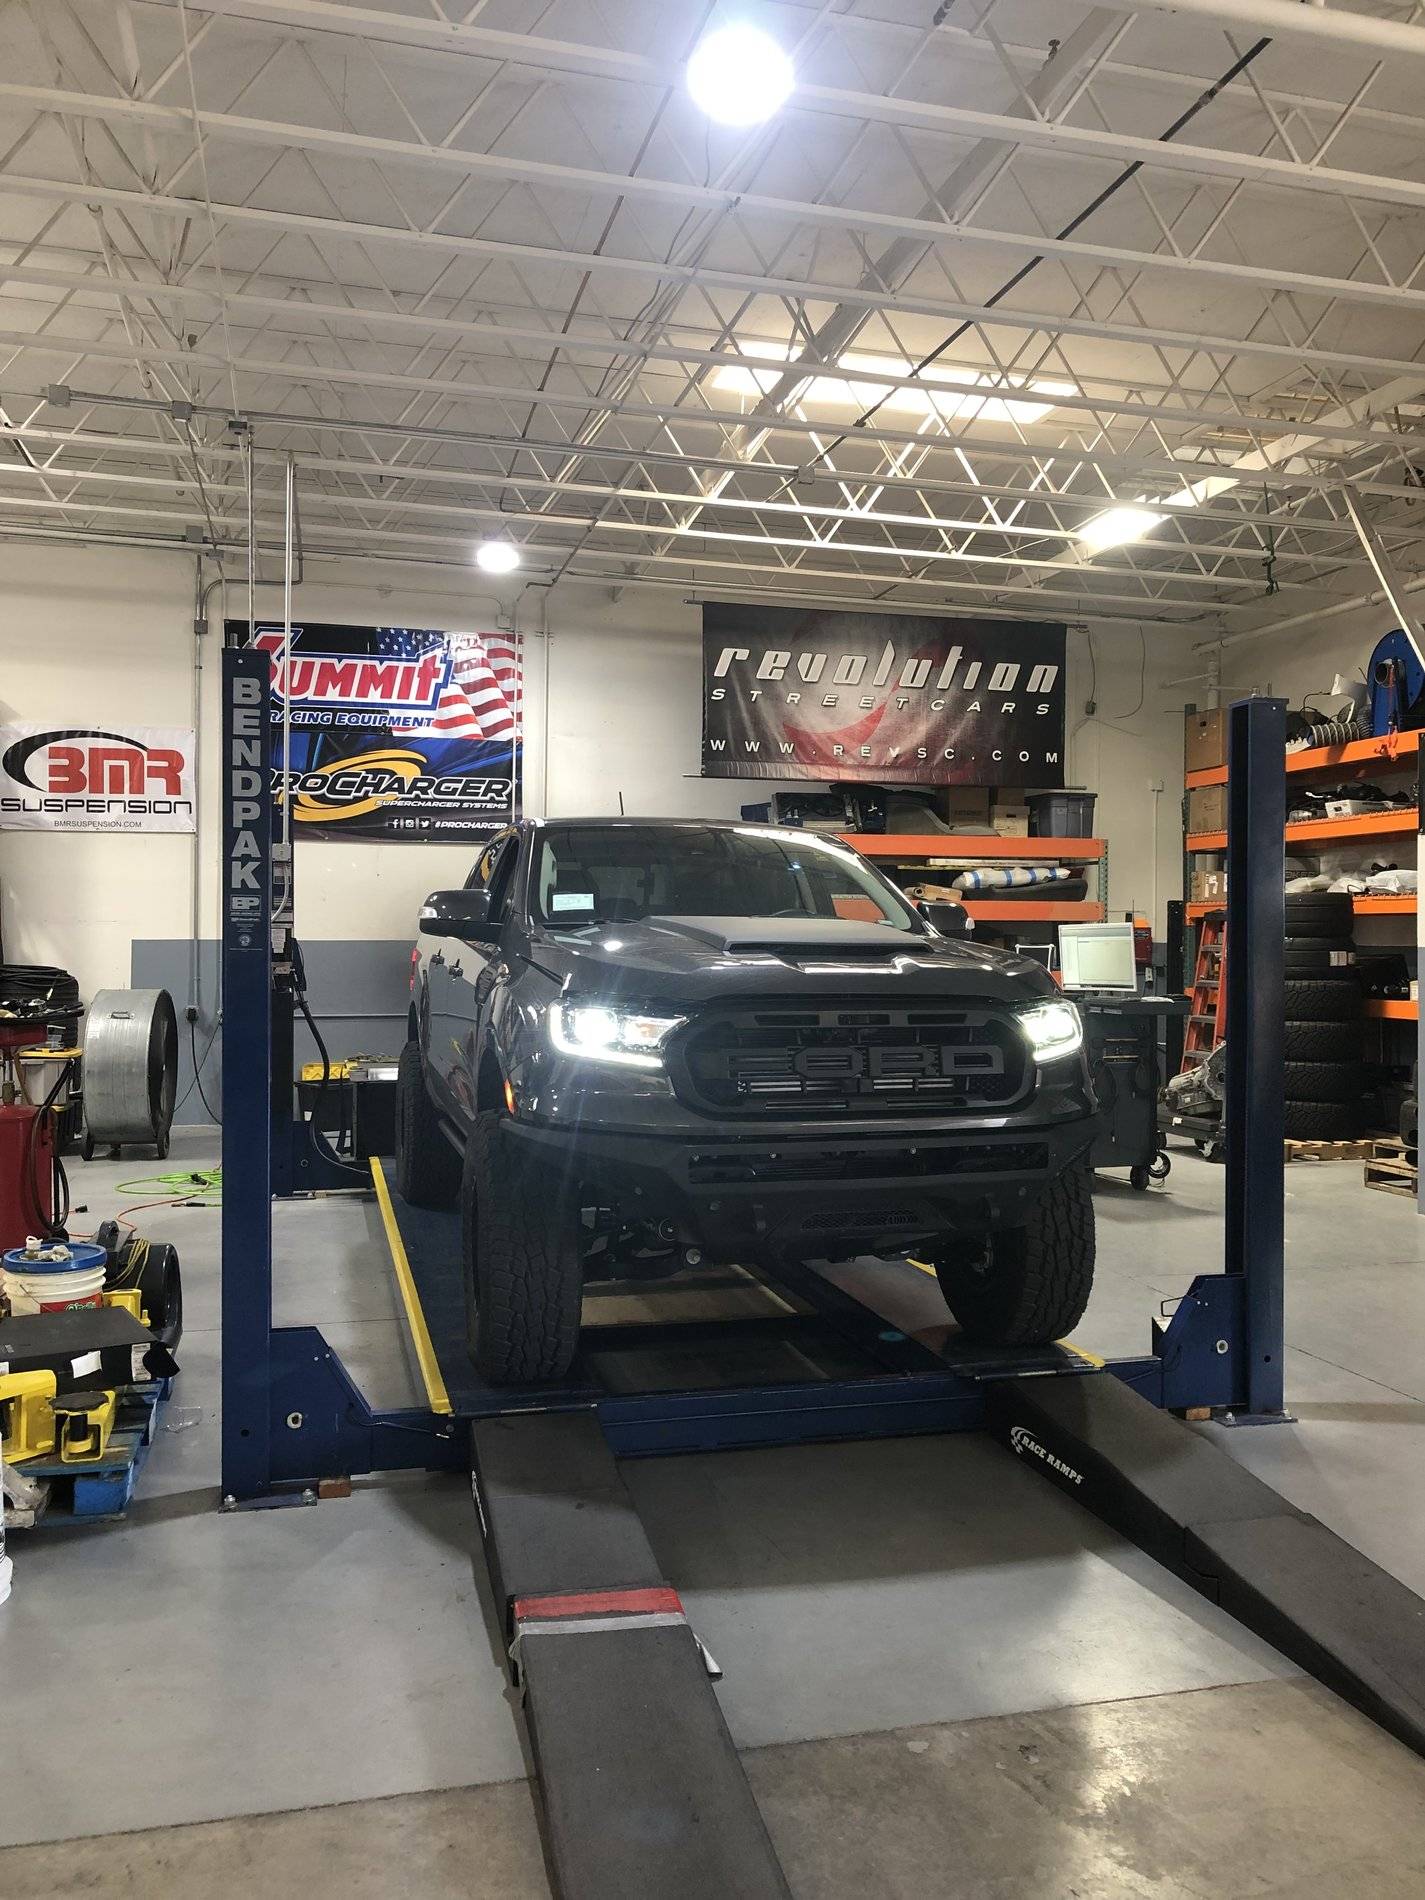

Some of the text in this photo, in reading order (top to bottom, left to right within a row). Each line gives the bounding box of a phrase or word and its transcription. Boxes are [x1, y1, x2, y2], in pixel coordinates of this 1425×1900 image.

[333, 711, 435, 728] EQUIPMENT
[48, 746, 185, 796] BMR
[231, 677, 262, 889] BENDPAK
[270, 768, 512, 801] ROCHARGER
[0, 798, 192, 815] SUSPENSION
[375, 799, 460, 808] SUPERCHARGER
[54, 820, 142, 828] BMRSUSPENSION.COM
[434, 821, 508, 830] #PROCHARGER
[231, 896, 260, 910] BP
[1021, 1435, 1083, 1485] RACE RAMPS
